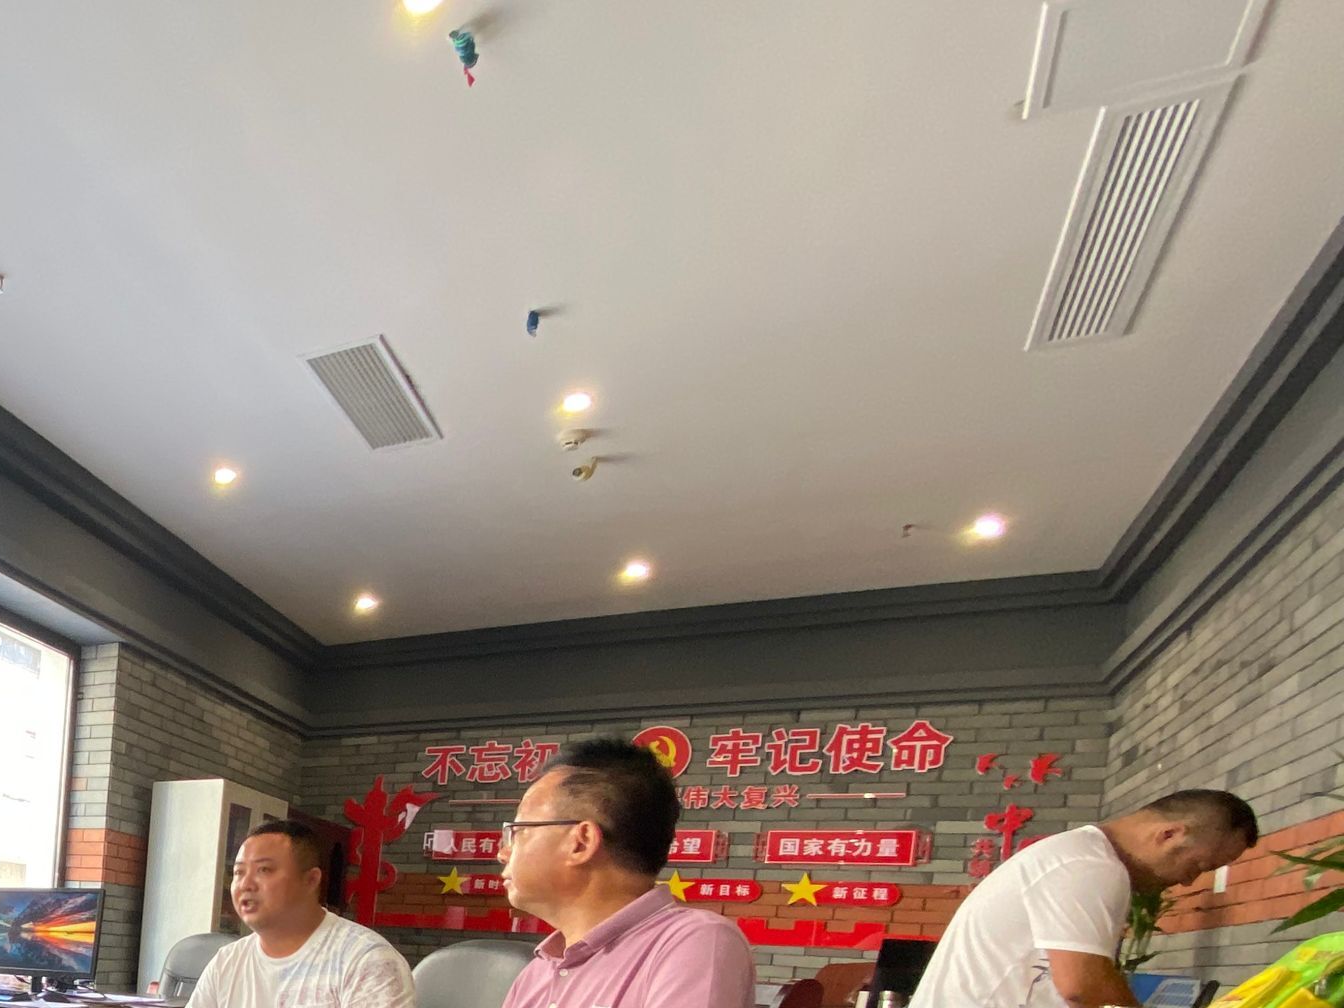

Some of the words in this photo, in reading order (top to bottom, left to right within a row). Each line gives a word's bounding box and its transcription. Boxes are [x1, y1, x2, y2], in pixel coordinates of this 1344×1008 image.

[707, 720, 953, 777] 牢记使命
[677, 784, 799, 809] 伟大复兴
[778, 837, 899, 857] 国家有力量
[699, 883, 750, 896] 新目标
[832, 886, 889, 900] 新征程
